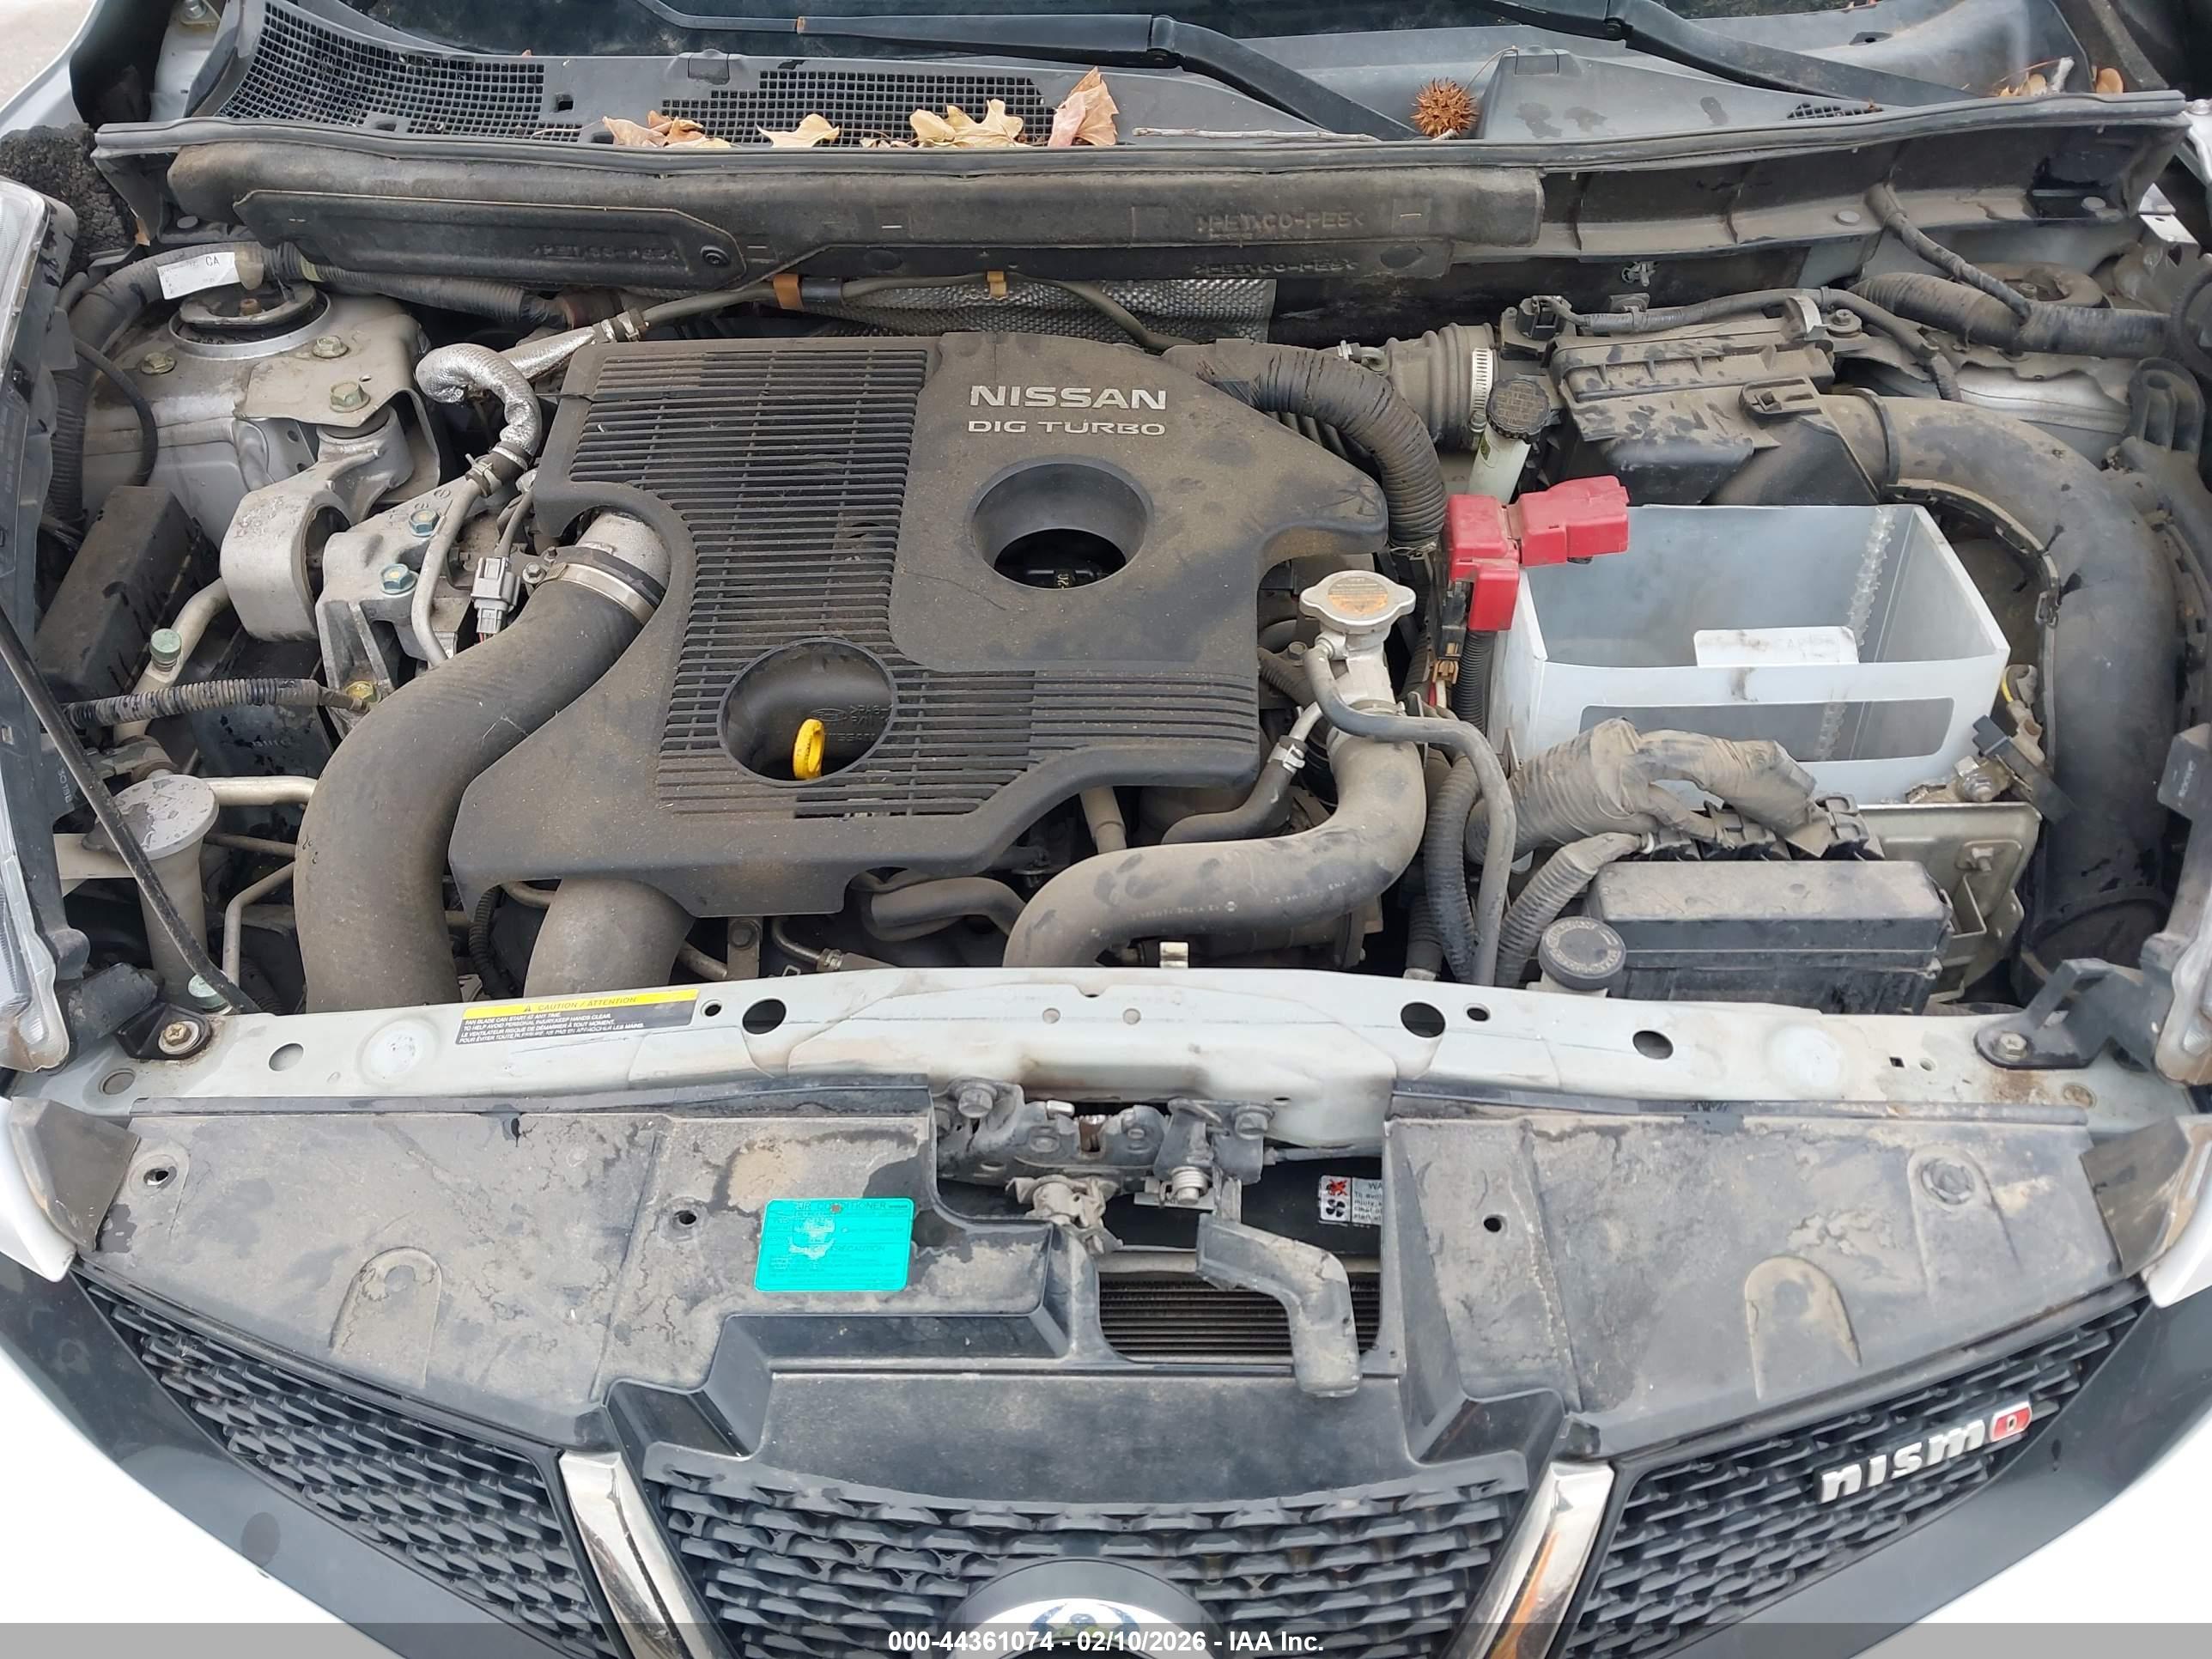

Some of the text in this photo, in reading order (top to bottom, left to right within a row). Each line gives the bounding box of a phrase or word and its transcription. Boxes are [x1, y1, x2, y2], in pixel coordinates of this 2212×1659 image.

[205, 256, 220, 267] CA
[969, 385, 1166, 410] NISSAN
[968, 421, 1166, 436] DIG TURBO
[538, 1002, 578, 1012] CAUTION
[586, 996, 637, 1006] ATTENTION
[1820, 1401, 2033, 1504] nismo
